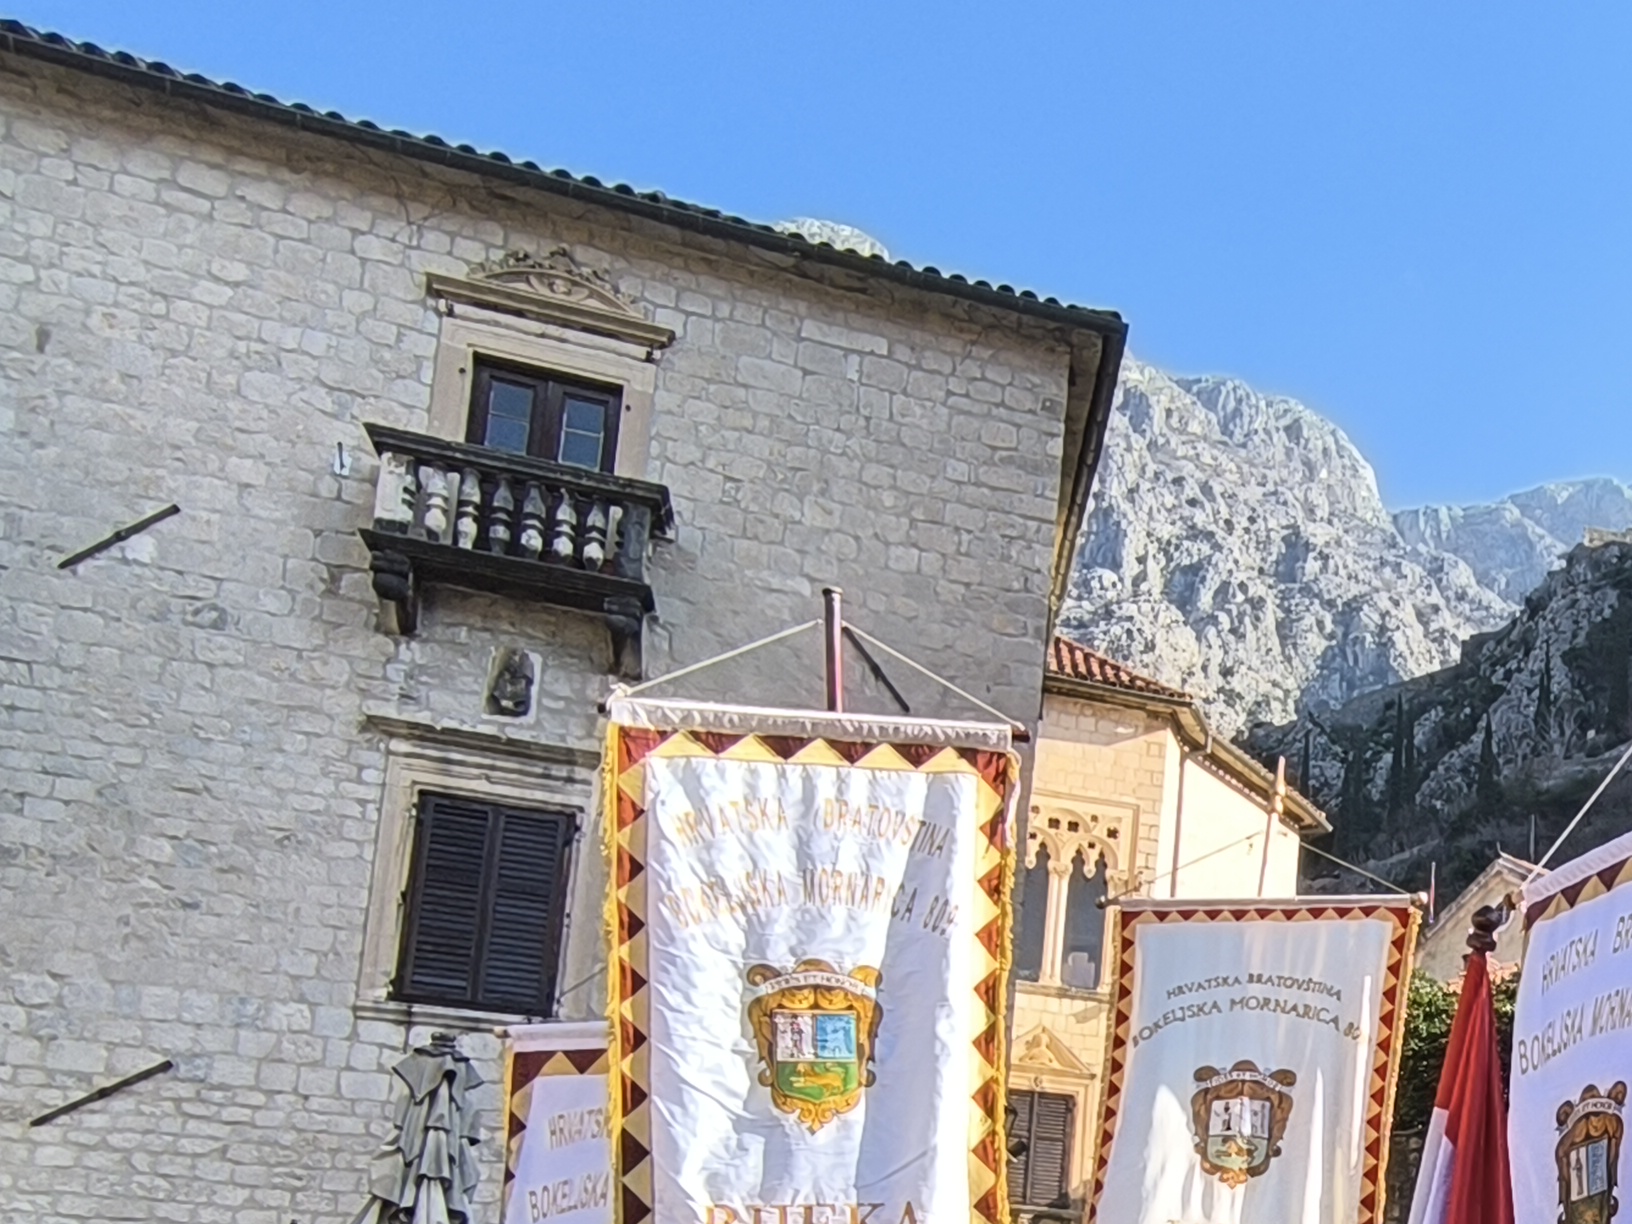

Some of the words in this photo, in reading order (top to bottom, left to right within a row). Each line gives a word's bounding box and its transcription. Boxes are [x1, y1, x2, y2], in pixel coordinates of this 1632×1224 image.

[672, 797, 789, 848] HRVATSKA
[1541, 928, 1599, 997] HRVATSKA
[1165, 975, 1242, 1000] HRVATSKA
[1228, 995, 1341, 1032] MORNARICA
